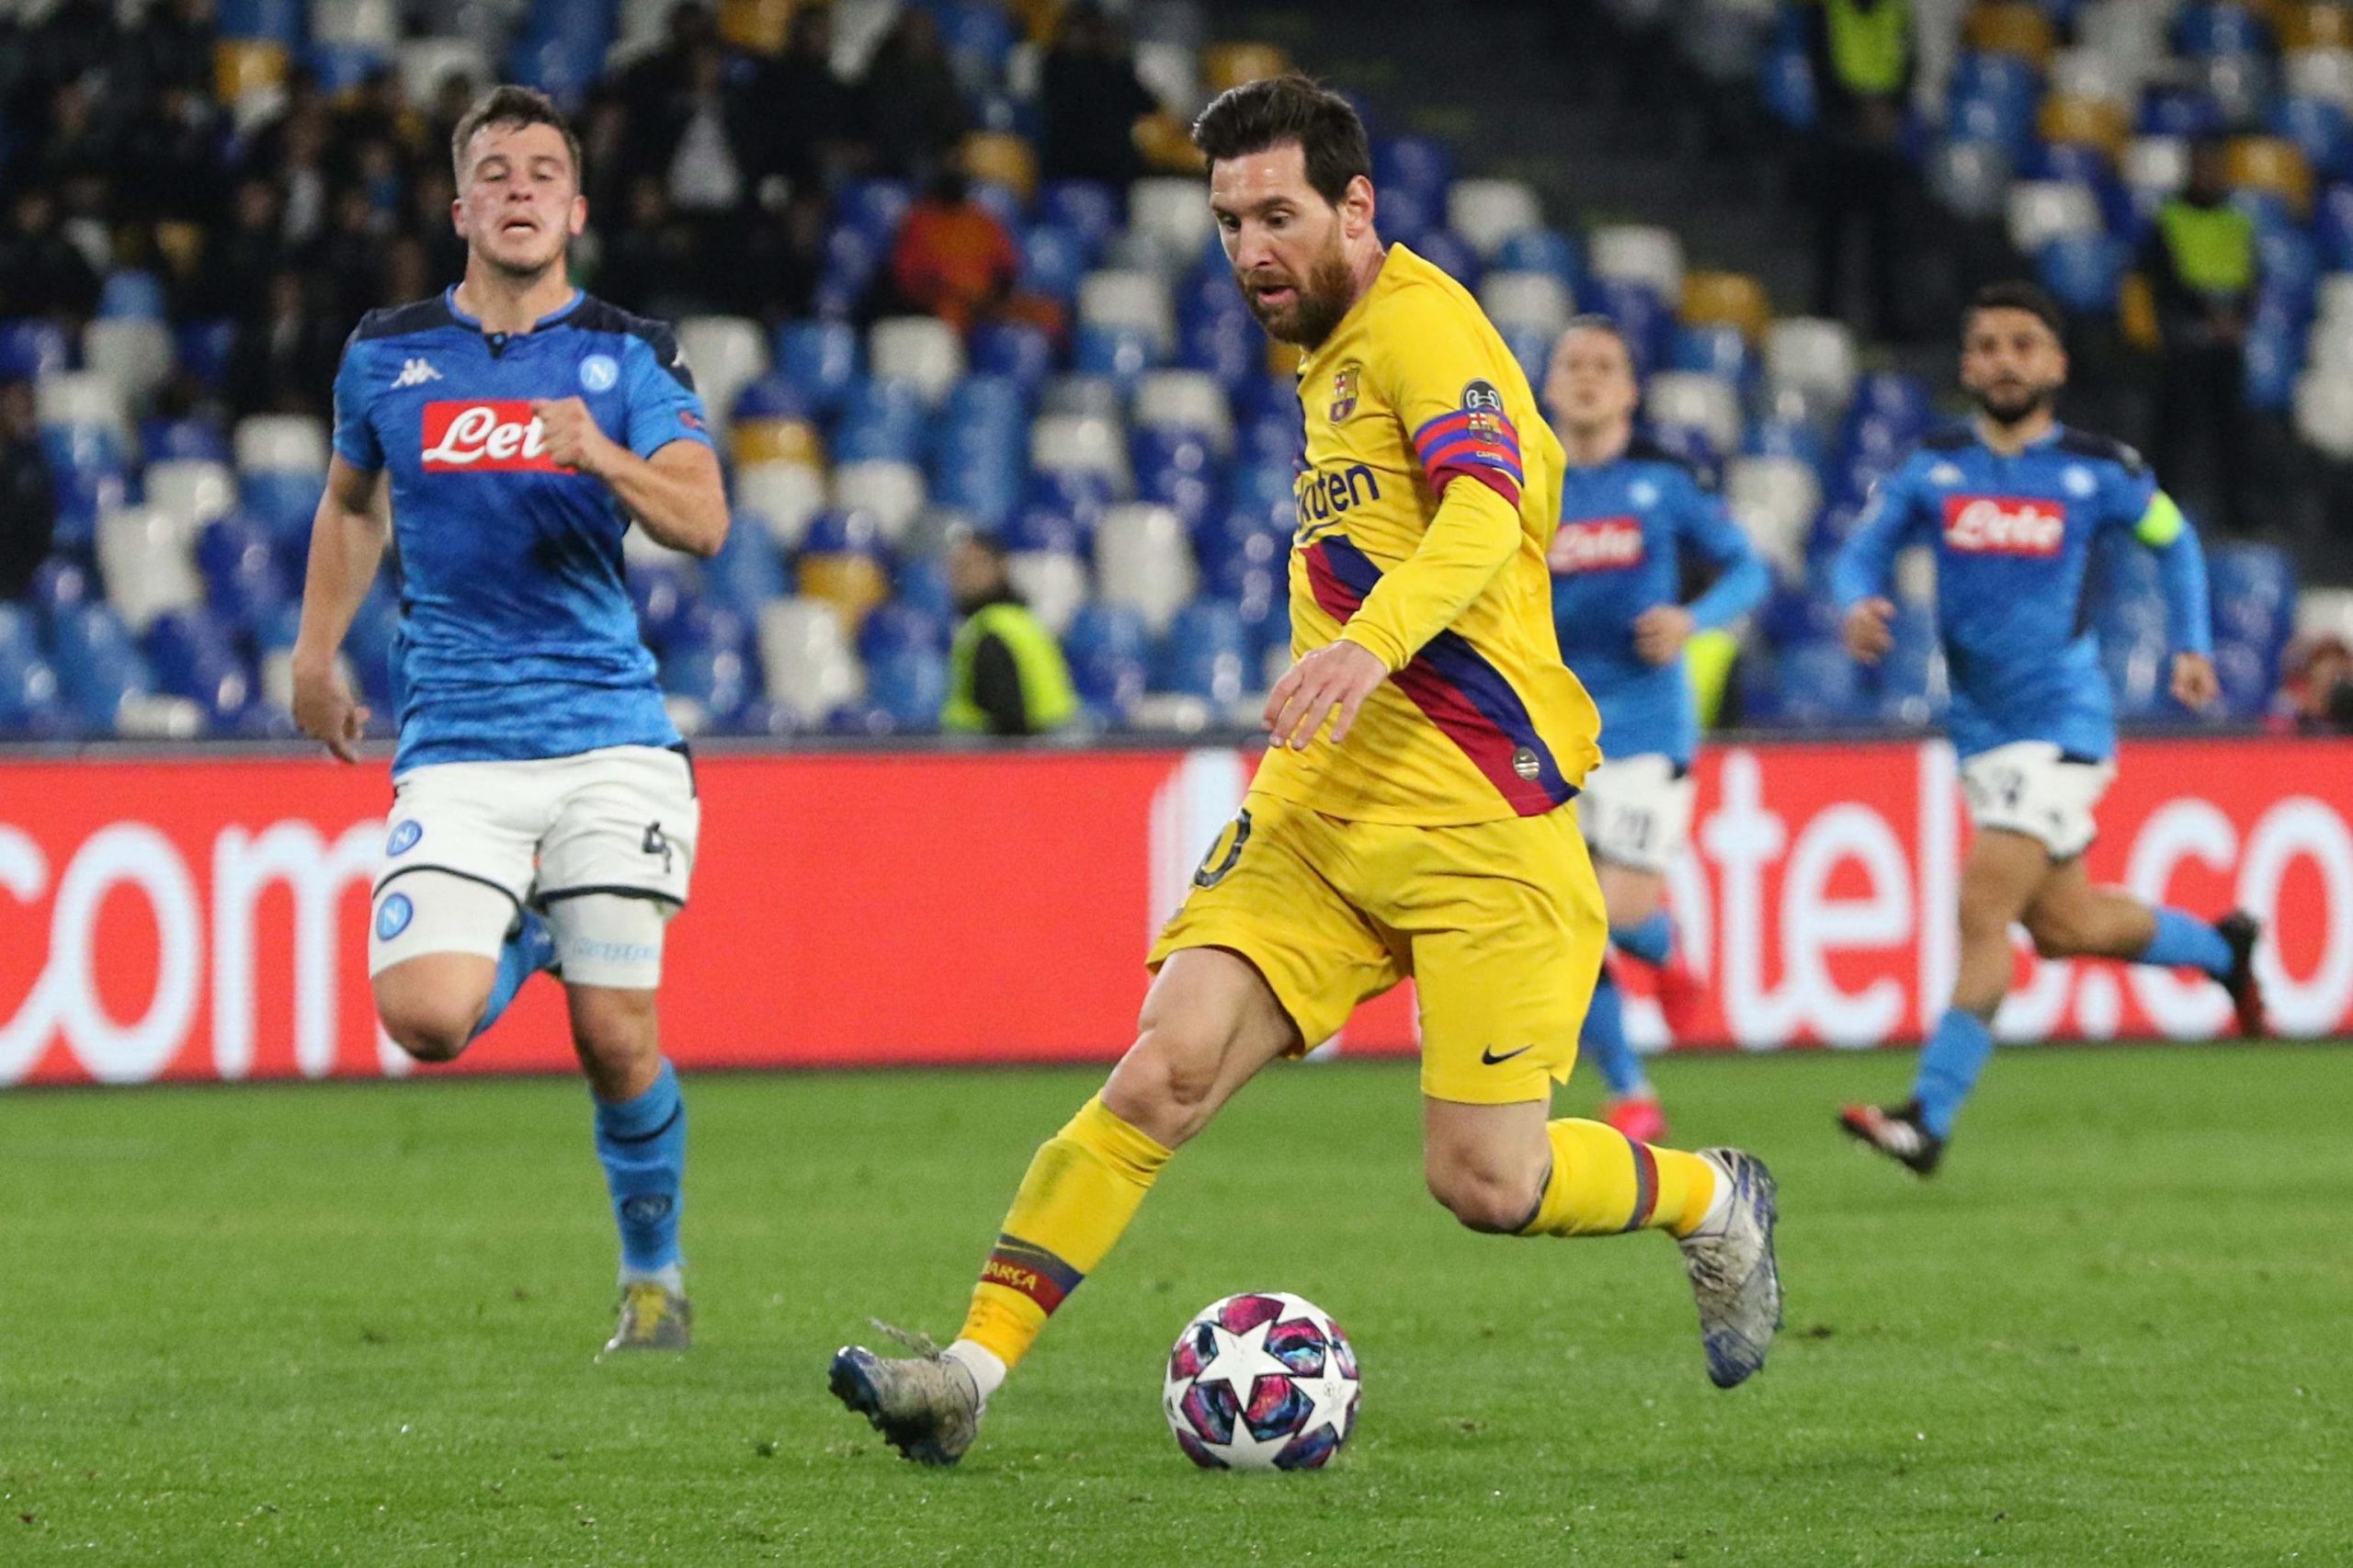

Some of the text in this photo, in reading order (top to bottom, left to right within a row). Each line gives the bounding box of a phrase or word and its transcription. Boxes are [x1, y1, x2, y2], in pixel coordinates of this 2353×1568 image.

[422, 405, 549, 463] Let
[1296, 464, 1381, 523] kuten
[642, 820, 673, 875] 4
[984, 1260, 1038, 1291] ARÇA
